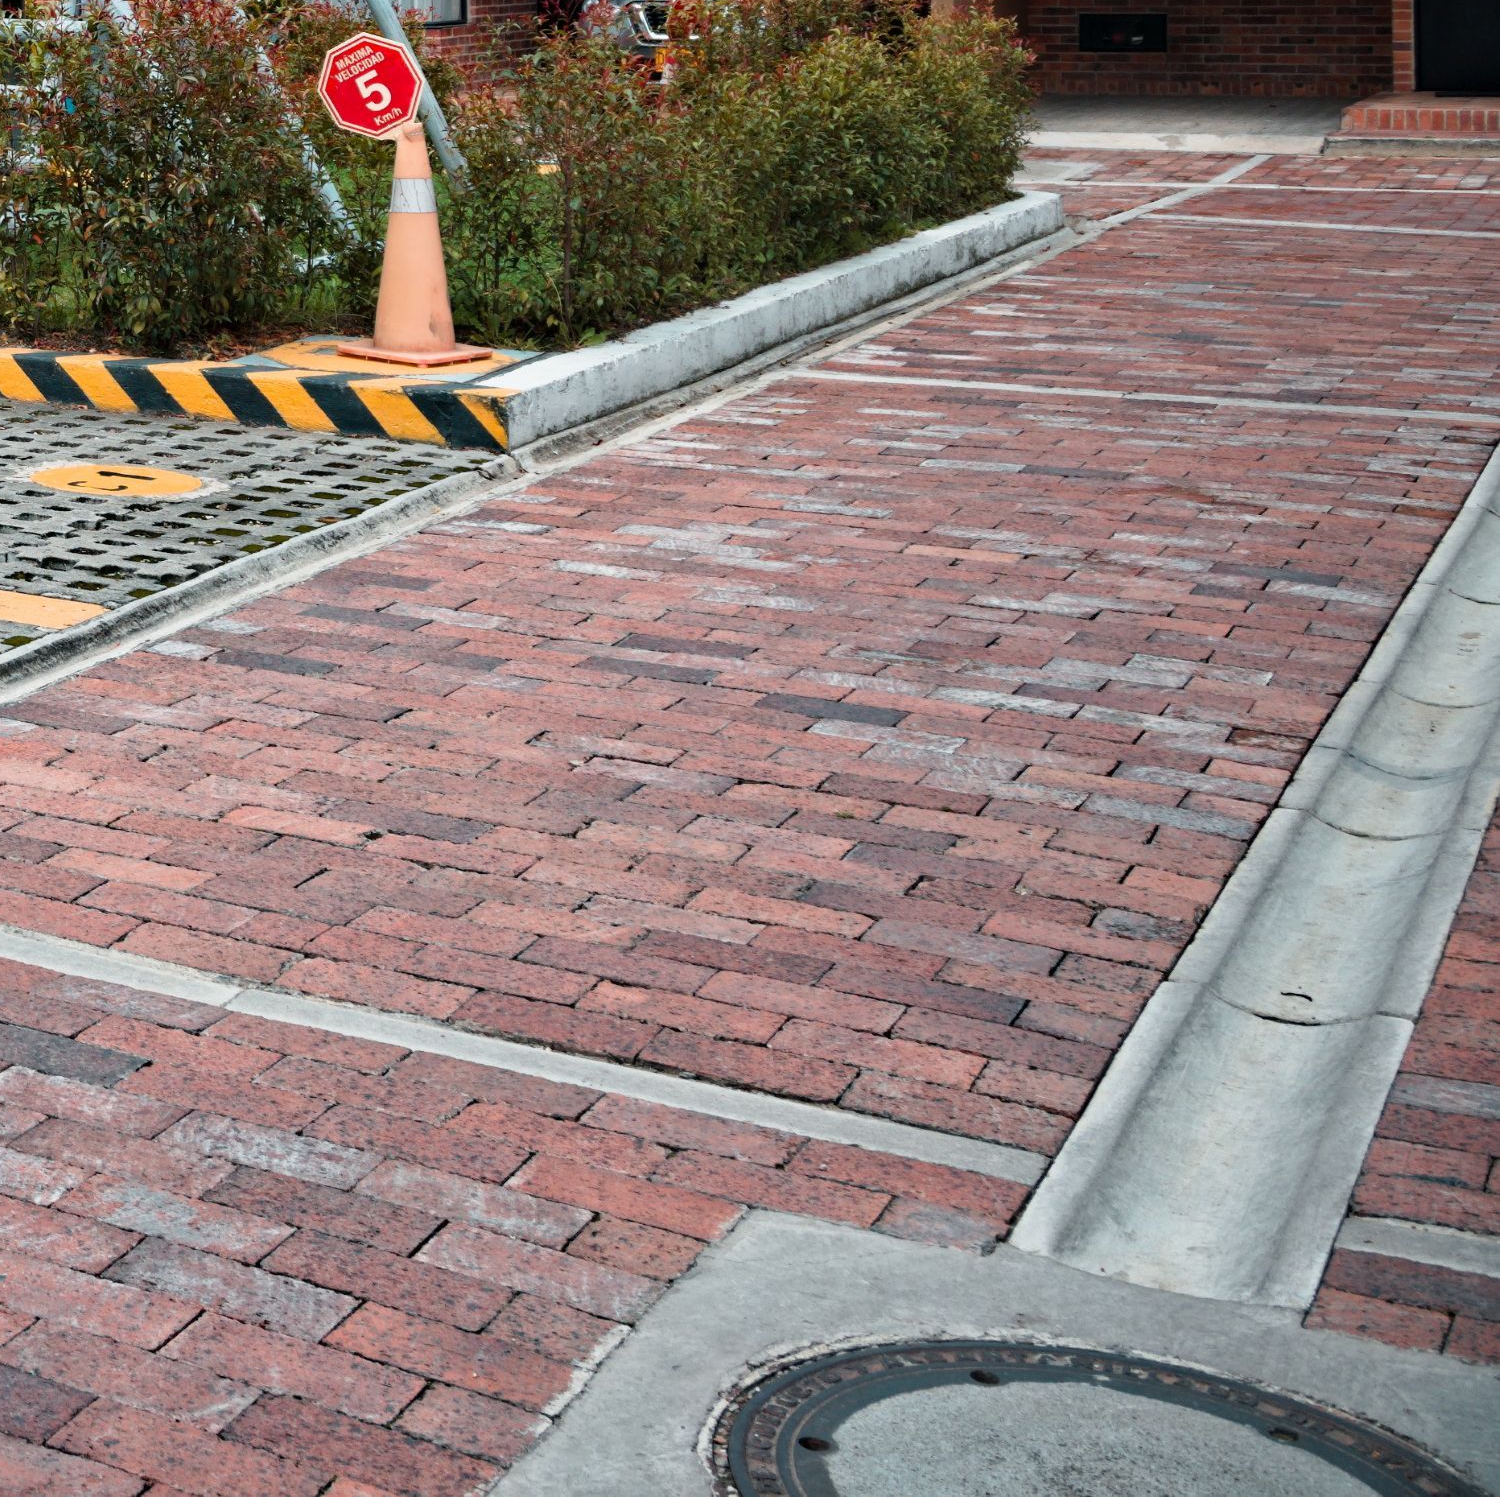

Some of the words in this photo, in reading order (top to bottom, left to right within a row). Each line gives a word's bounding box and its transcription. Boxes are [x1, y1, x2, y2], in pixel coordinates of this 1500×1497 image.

[334, 51, 385, 83] VELOCIDAD
[355, 69, 392, 112] 5
[373, 107, 403, 126] Km/h
